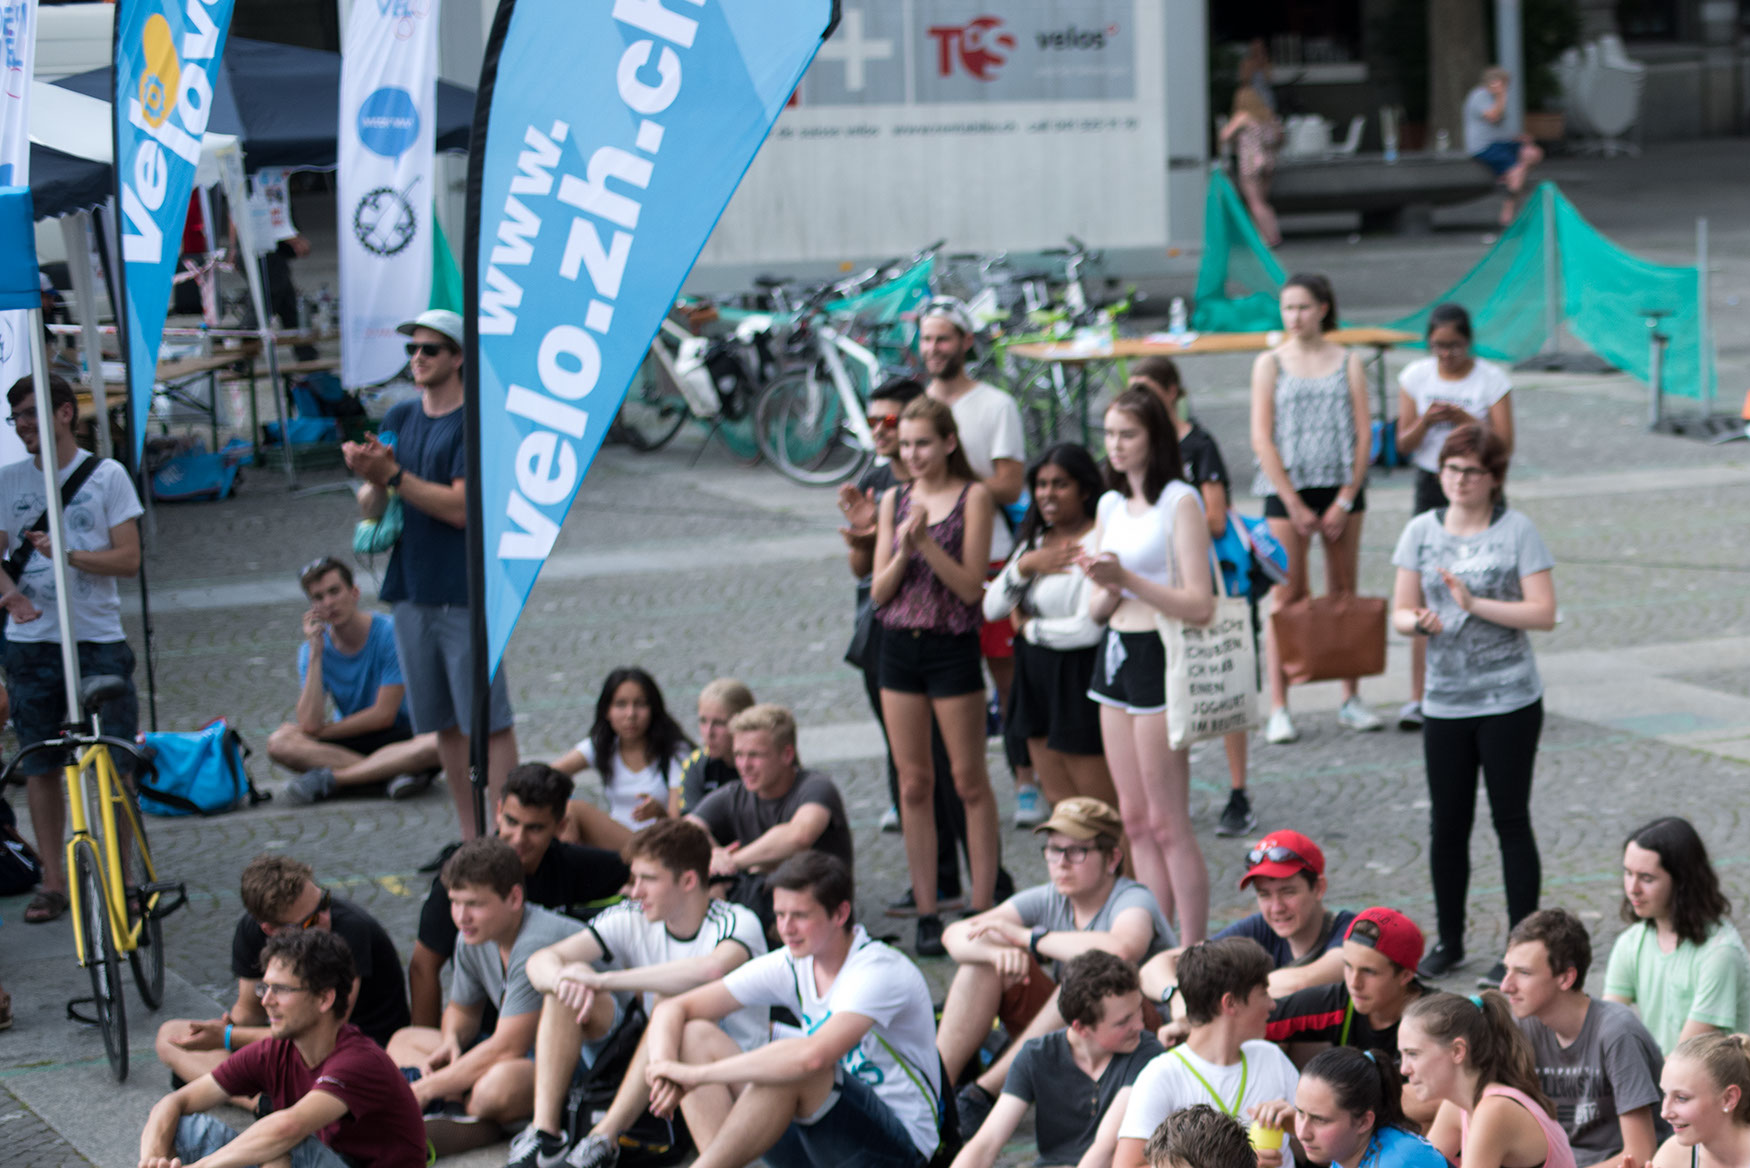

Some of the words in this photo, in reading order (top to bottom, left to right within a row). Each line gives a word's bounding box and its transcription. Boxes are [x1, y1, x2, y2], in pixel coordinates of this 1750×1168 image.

[927, 16, 1019, 82] TCS
[478, 119, 570, 336] www.
[497, 0, 700, 560] velo.zh.ch
